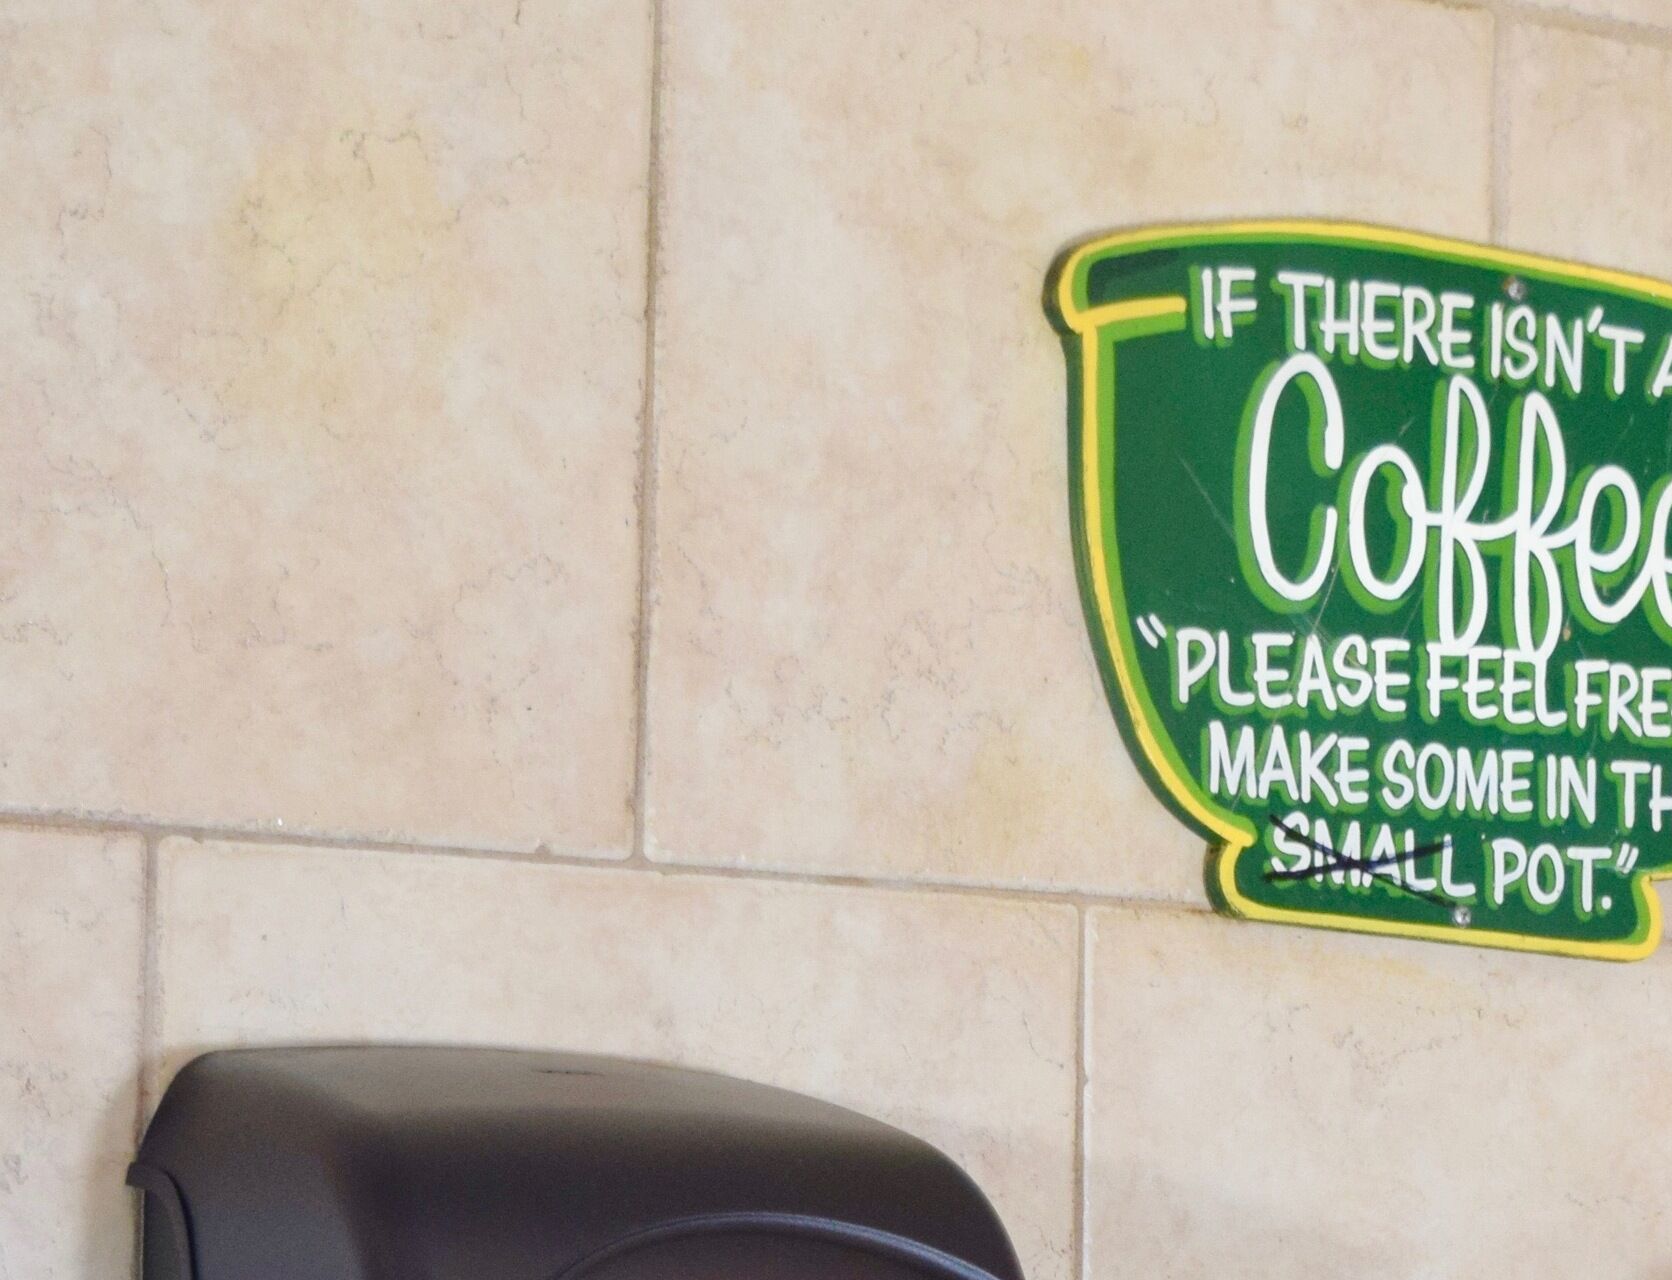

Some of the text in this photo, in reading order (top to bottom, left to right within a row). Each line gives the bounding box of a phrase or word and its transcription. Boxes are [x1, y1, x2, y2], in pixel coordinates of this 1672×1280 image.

[1202, 267, 1257, 339] IF
[1277, 272, 1475, 369] THERE
[1490, 304, 1644, 396] ISN'T
[1426, 643, 1567, 727] FEEL
[1207, 721, 1370, 805] MAKE
[1381, 742, 1535, 814] SOME
[1546, 755, 1597, 825] IN
[1271, 811, 1476, 898] SMALL
